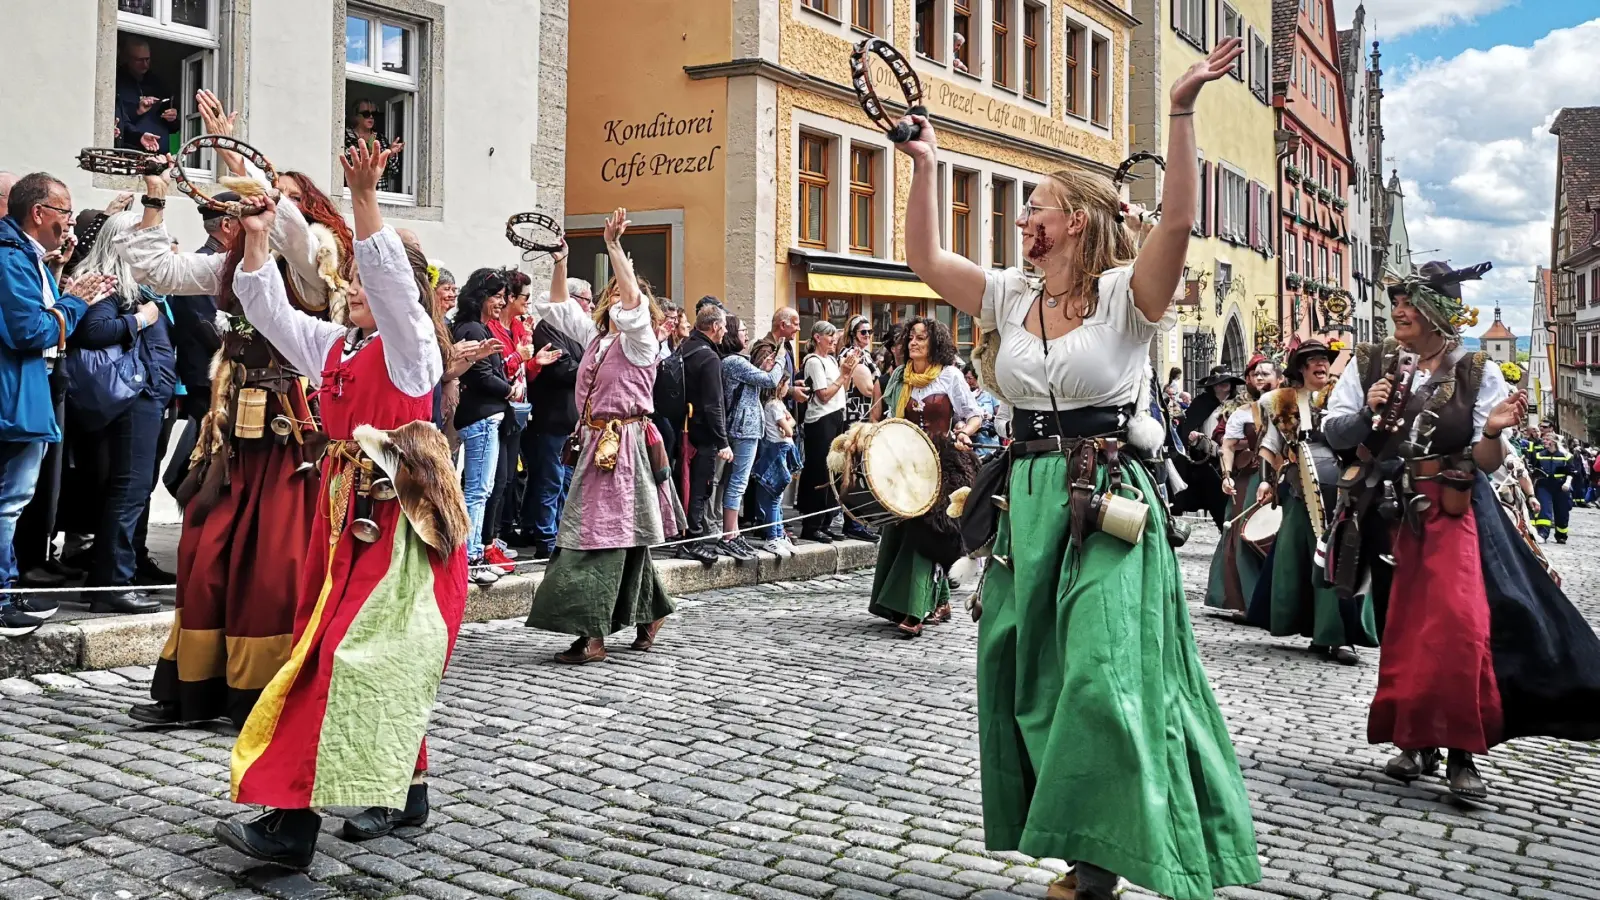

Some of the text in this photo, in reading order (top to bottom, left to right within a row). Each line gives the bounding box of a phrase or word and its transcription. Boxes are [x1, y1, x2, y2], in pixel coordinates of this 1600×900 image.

[603, 109, 714, 146] Konditorei
[939, 83, 977, 115] Prezel
[987, 98, 1011, 128] Café
[1012, 115, 1026, 131] am
[1029, 115, 1079, 148] Marktplatz
[601, 145, 721, 186] Café Prezel
